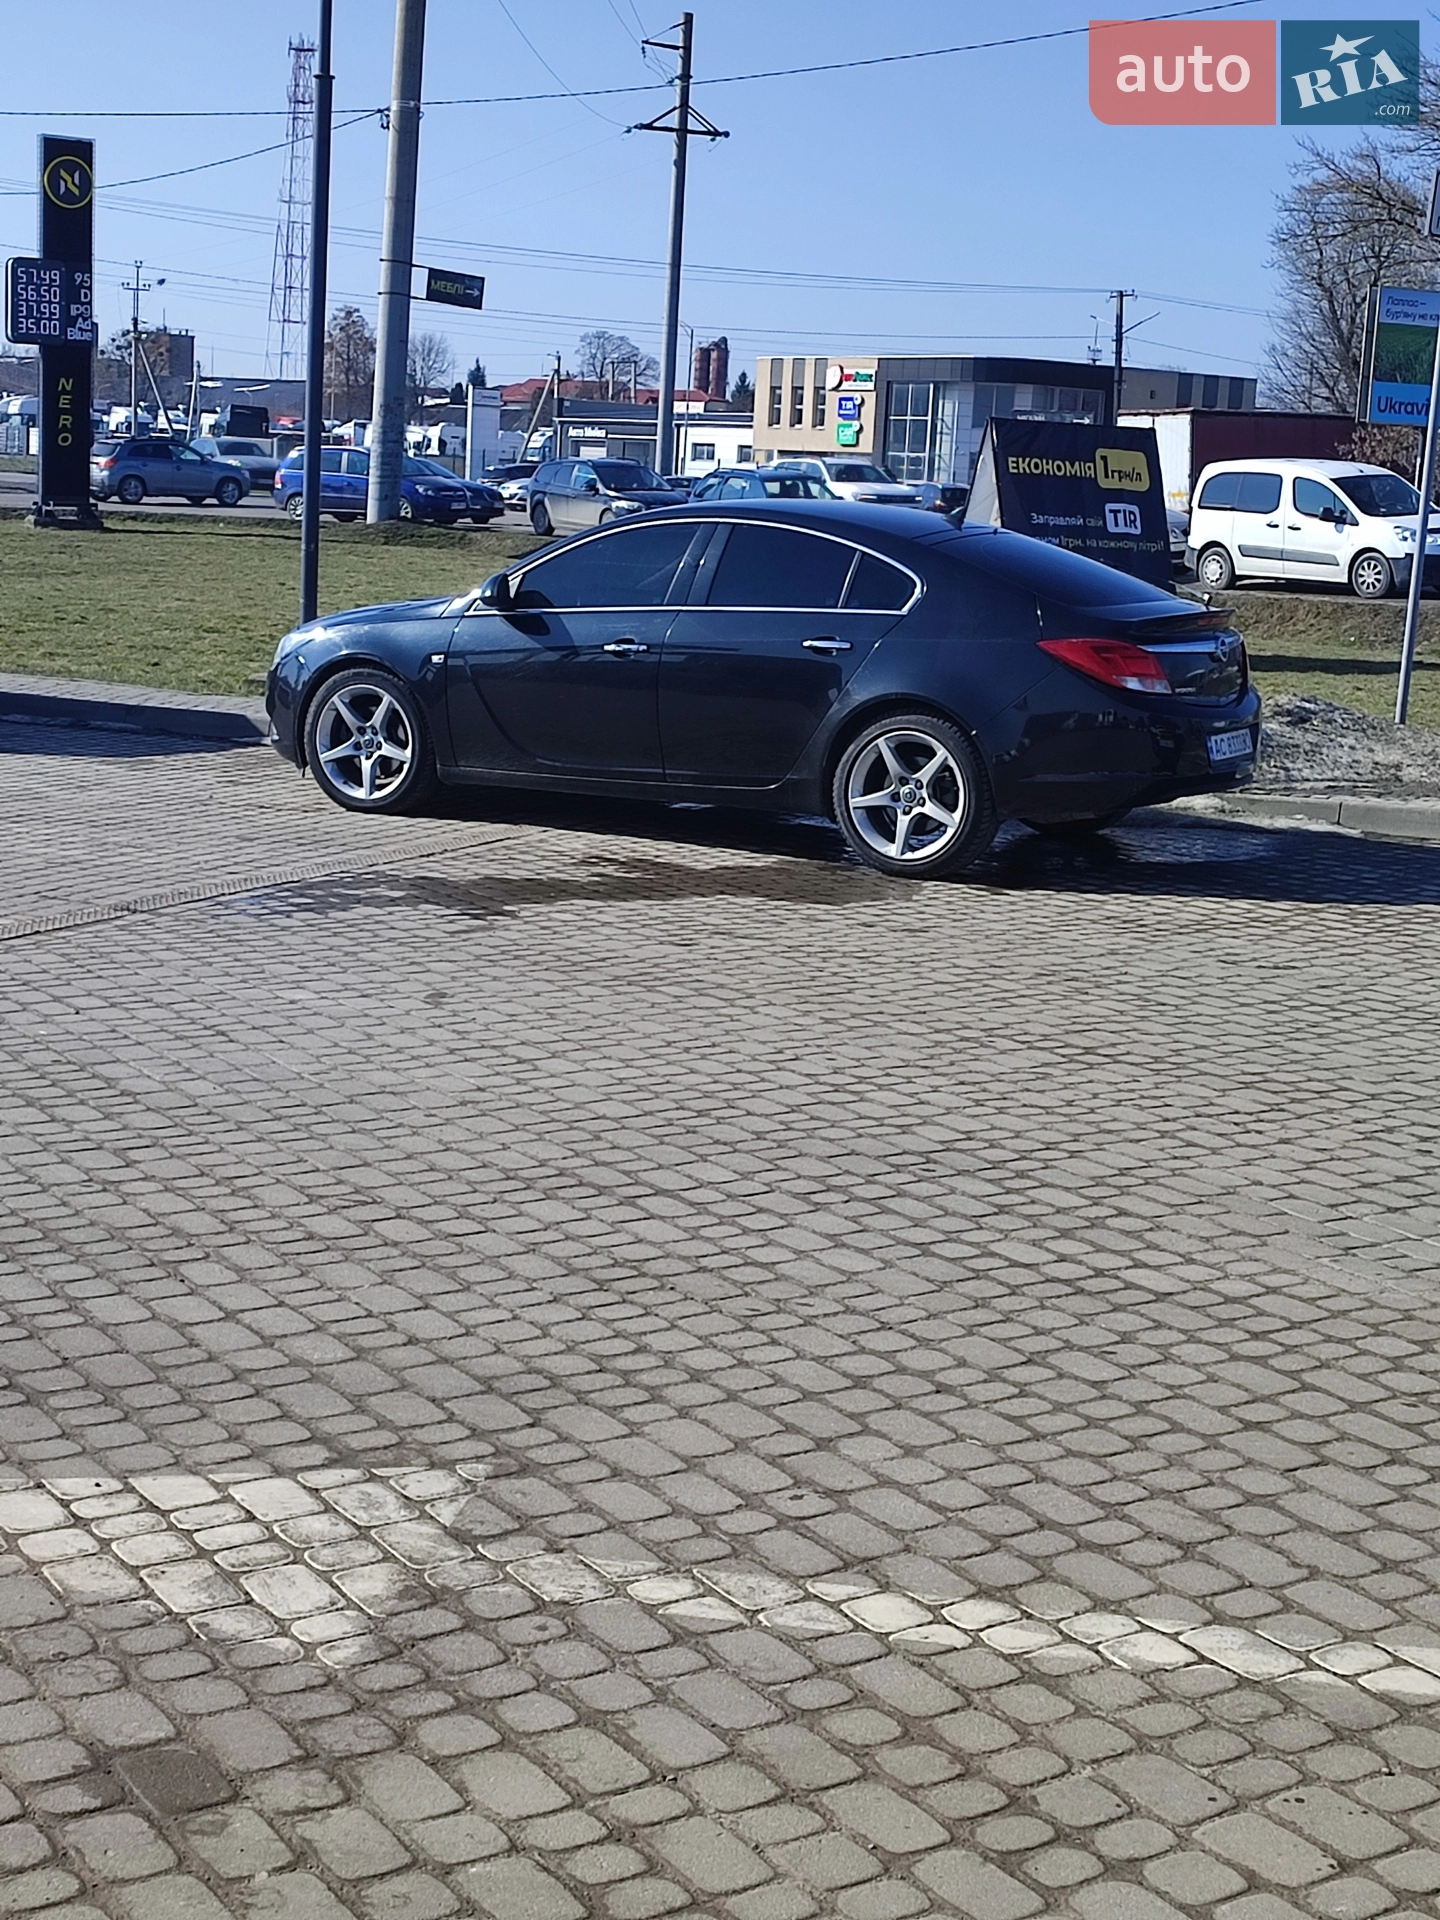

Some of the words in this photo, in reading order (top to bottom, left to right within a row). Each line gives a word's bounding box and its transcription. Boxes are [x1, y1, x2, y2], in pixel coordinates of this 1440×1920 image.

[17, 267, 60, 286] 57.49
[74, 272, 91, 287] 95
[17, 284, 60, 302] 56.50
[80, 288, 91, 302] D
[18, 301, 60, 319] 37.99
[18, 318, 60, 335] 35.00
[58, 377, 74, 446] NERO
[1008, 456, 1095, 479] ЕКОНОМІЯ
[1030, 513, 1084, 527] Заправляй
[1109, 509, 1138, 530] TIR
